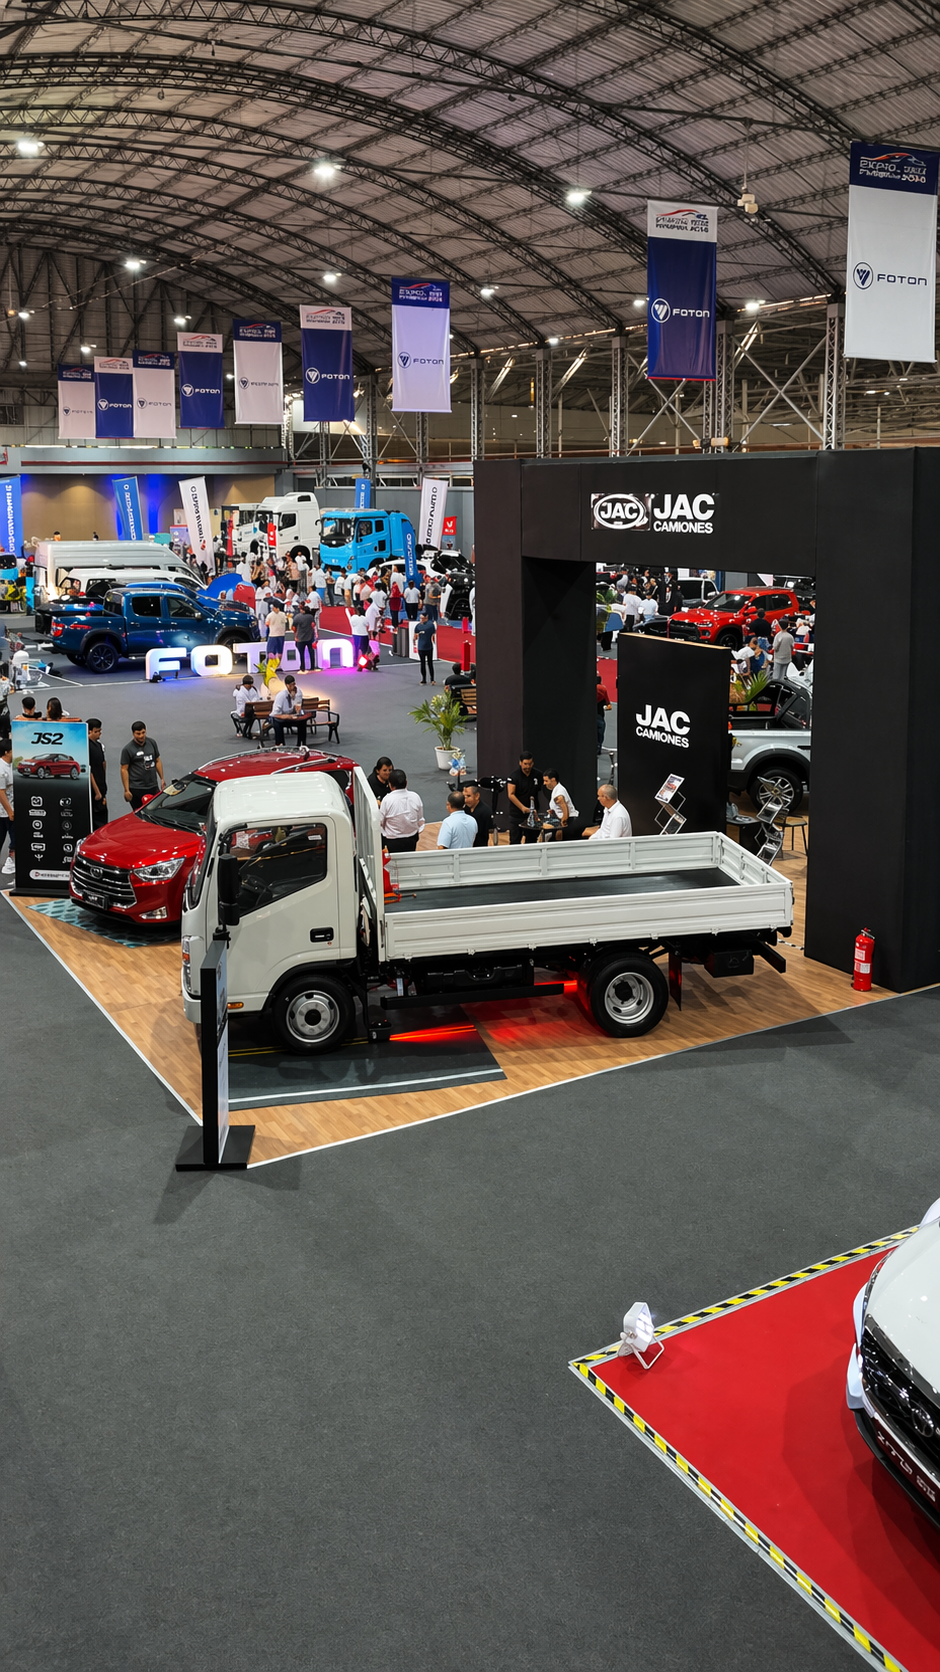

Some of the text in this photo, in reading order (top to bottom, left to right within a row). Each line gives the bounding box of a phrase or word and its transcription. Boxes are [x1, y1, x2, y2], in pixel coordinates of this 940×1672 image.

[877, 273, 927, 286] FOTON
[672, 308, 710, 318] FOTON
[600, 502, 638, 519] JAC
[653, 494, 715, 520] JAC
[653, 521, 713, 534] CAMIONES
[635, 704, 691, 735] JAC
[31, 732, 64, 745] JS2
[635, 726, 690, 748] CAMIONES
